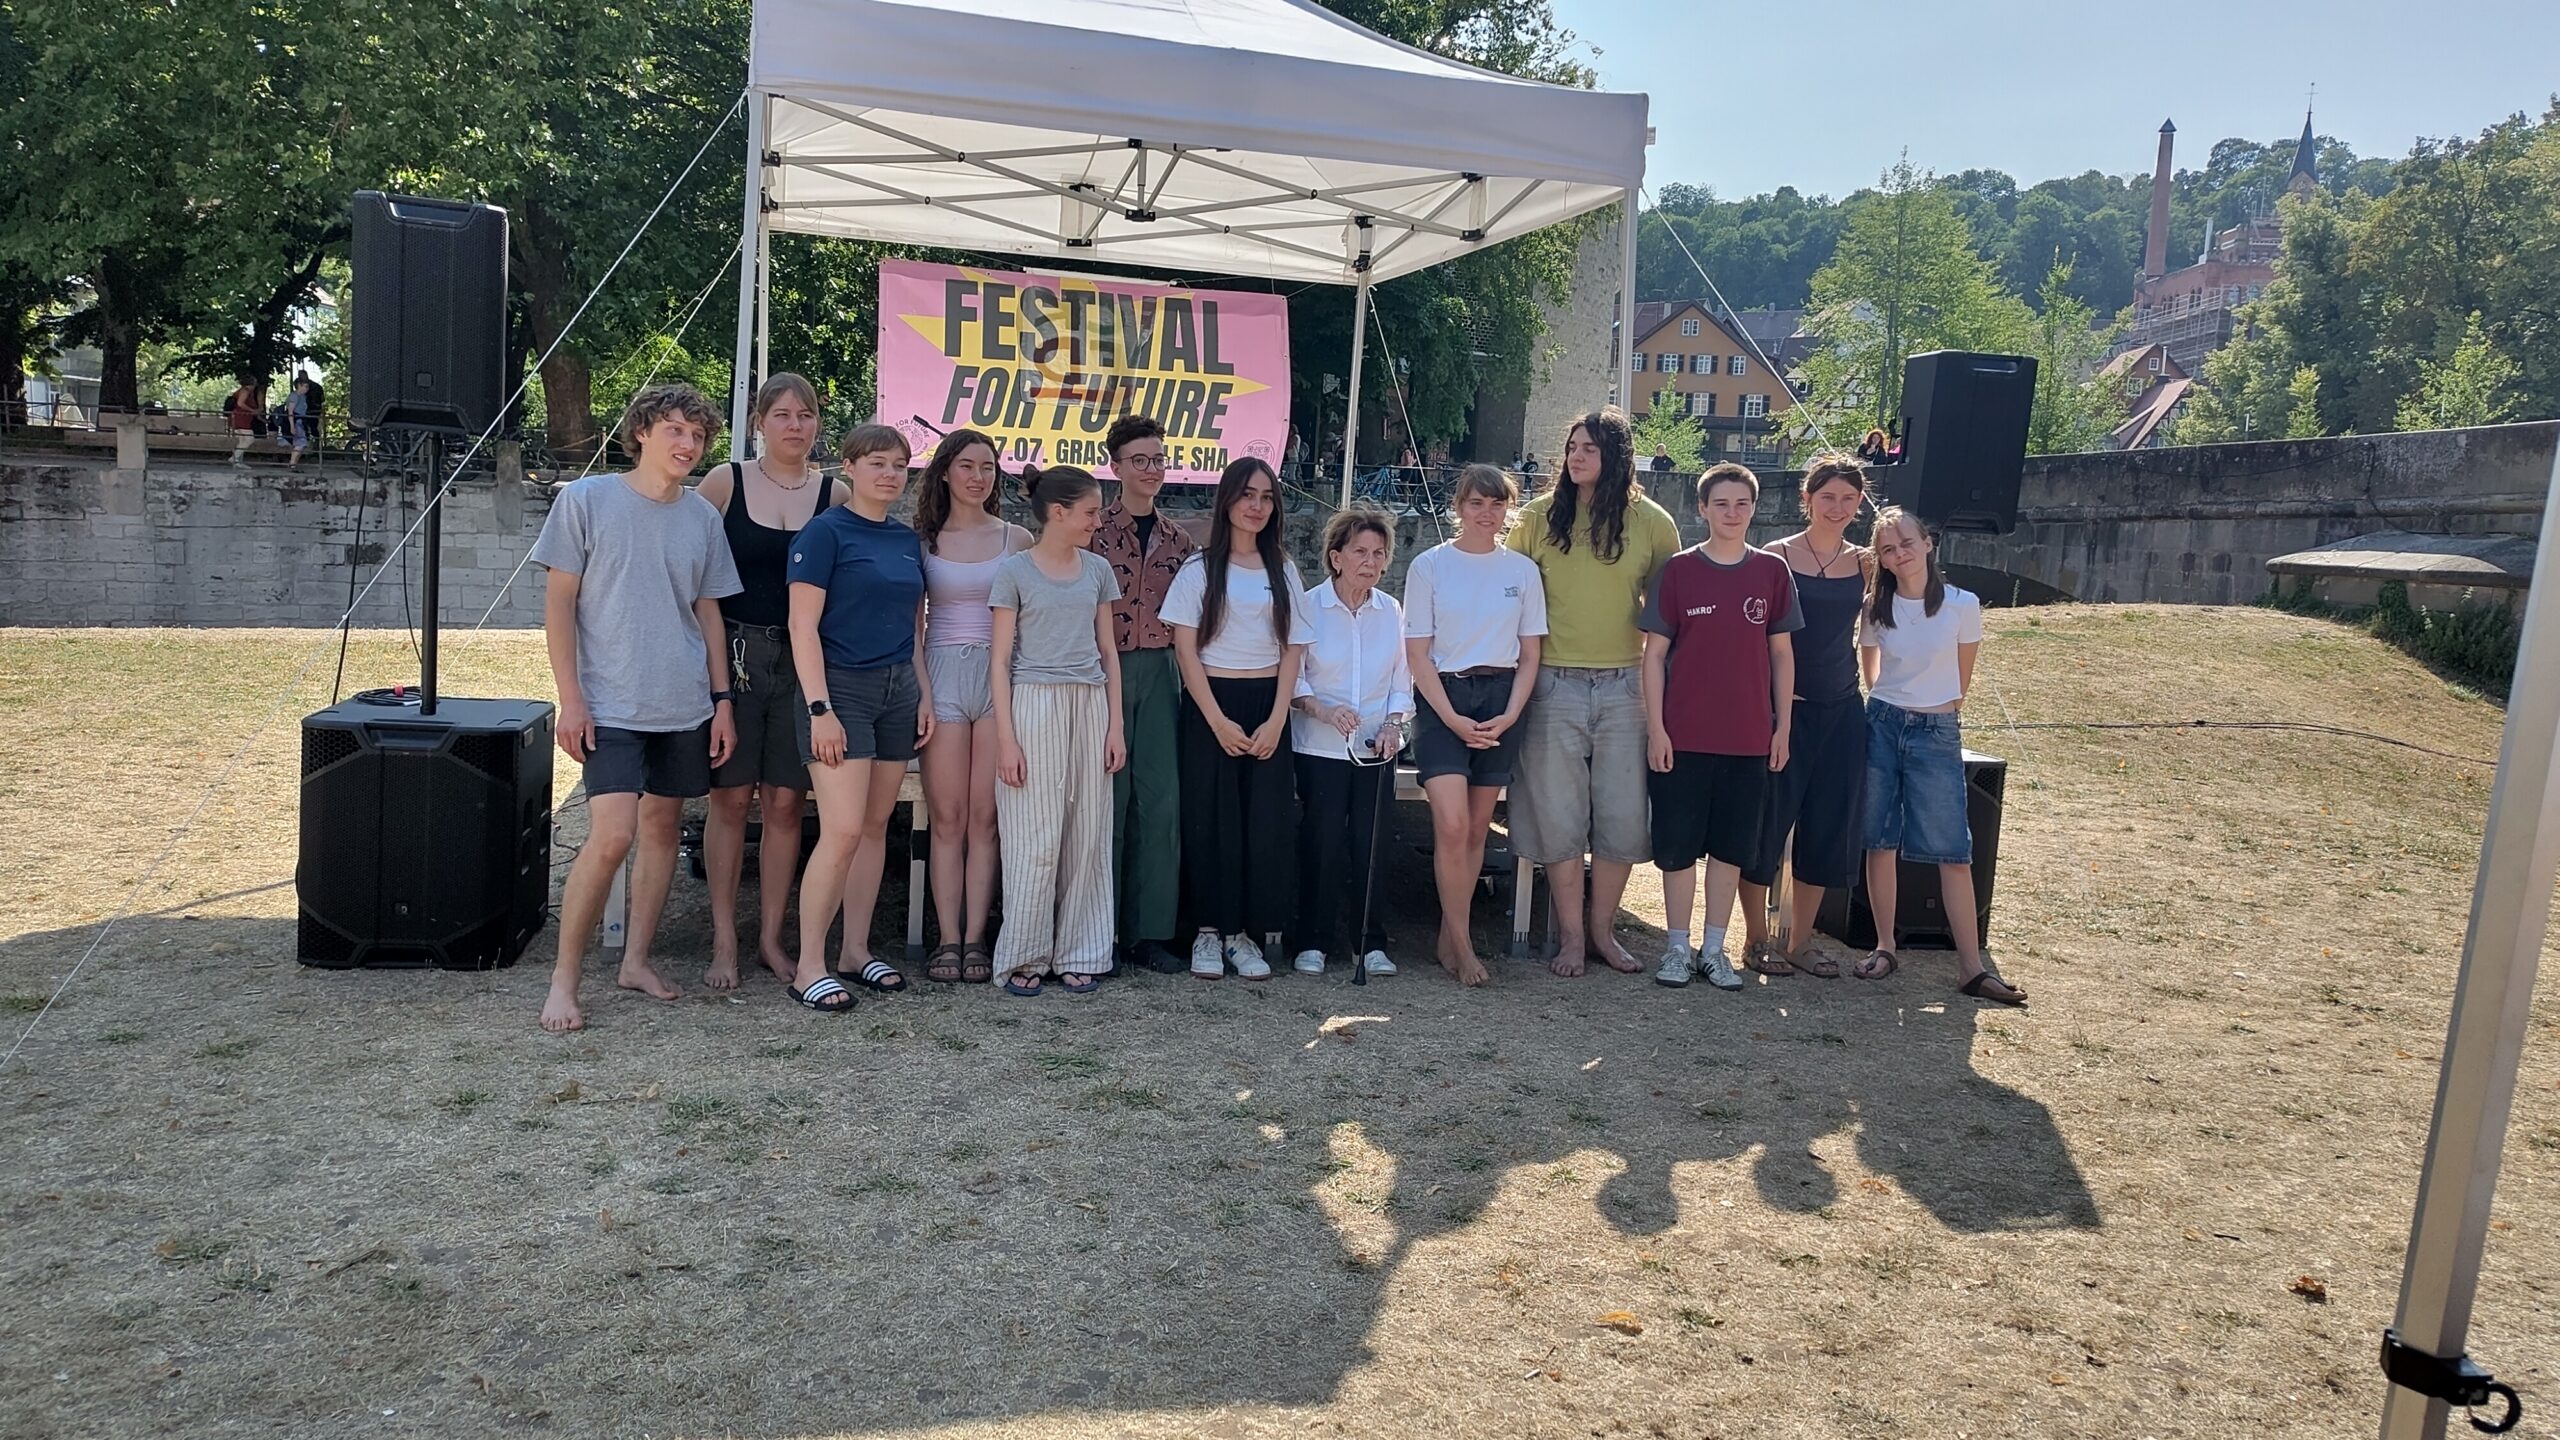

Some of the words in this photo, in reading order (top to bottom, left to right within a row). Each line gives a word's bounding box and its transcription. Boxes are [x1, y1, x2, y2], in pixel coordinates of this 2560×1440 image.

[944, 279, 1234, 376] FESTIVAL
[941, 365, 1044, 429] FOR
[1050, 372, 1234, 440] FUTURE
[896, 418, 909, 428] FOR
[910, 419, 930, 438] FUTURE
[993, 435, 1048, 464] 7.07.
[1190, 446, 1229, 472] SHA
[1686, 606, 1712, 617] HAKRO
